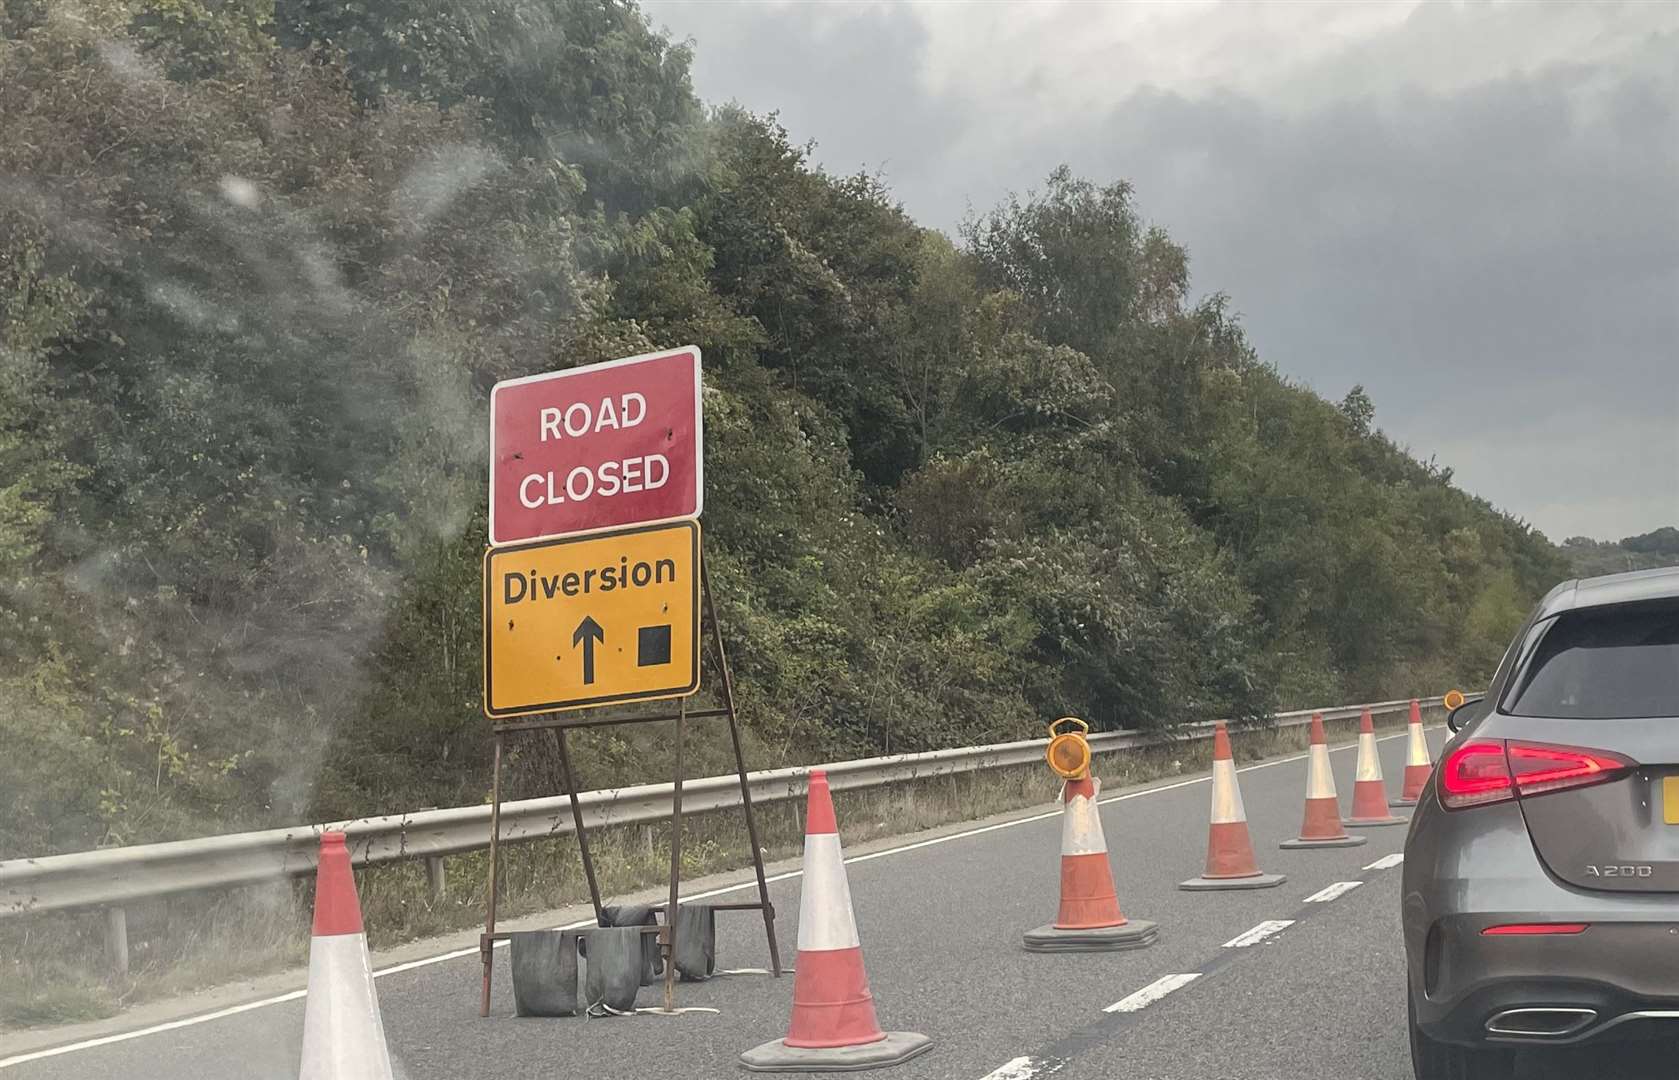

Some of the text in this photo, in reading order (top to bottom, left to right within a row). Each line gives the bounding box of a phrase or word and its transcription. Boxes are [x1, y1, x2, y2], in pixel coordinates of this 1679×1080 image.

[540, 392, 647, 442] ROAD
[519, 453, 669, 509] CLOSED
[504, 556, 675, 605] Diversion
